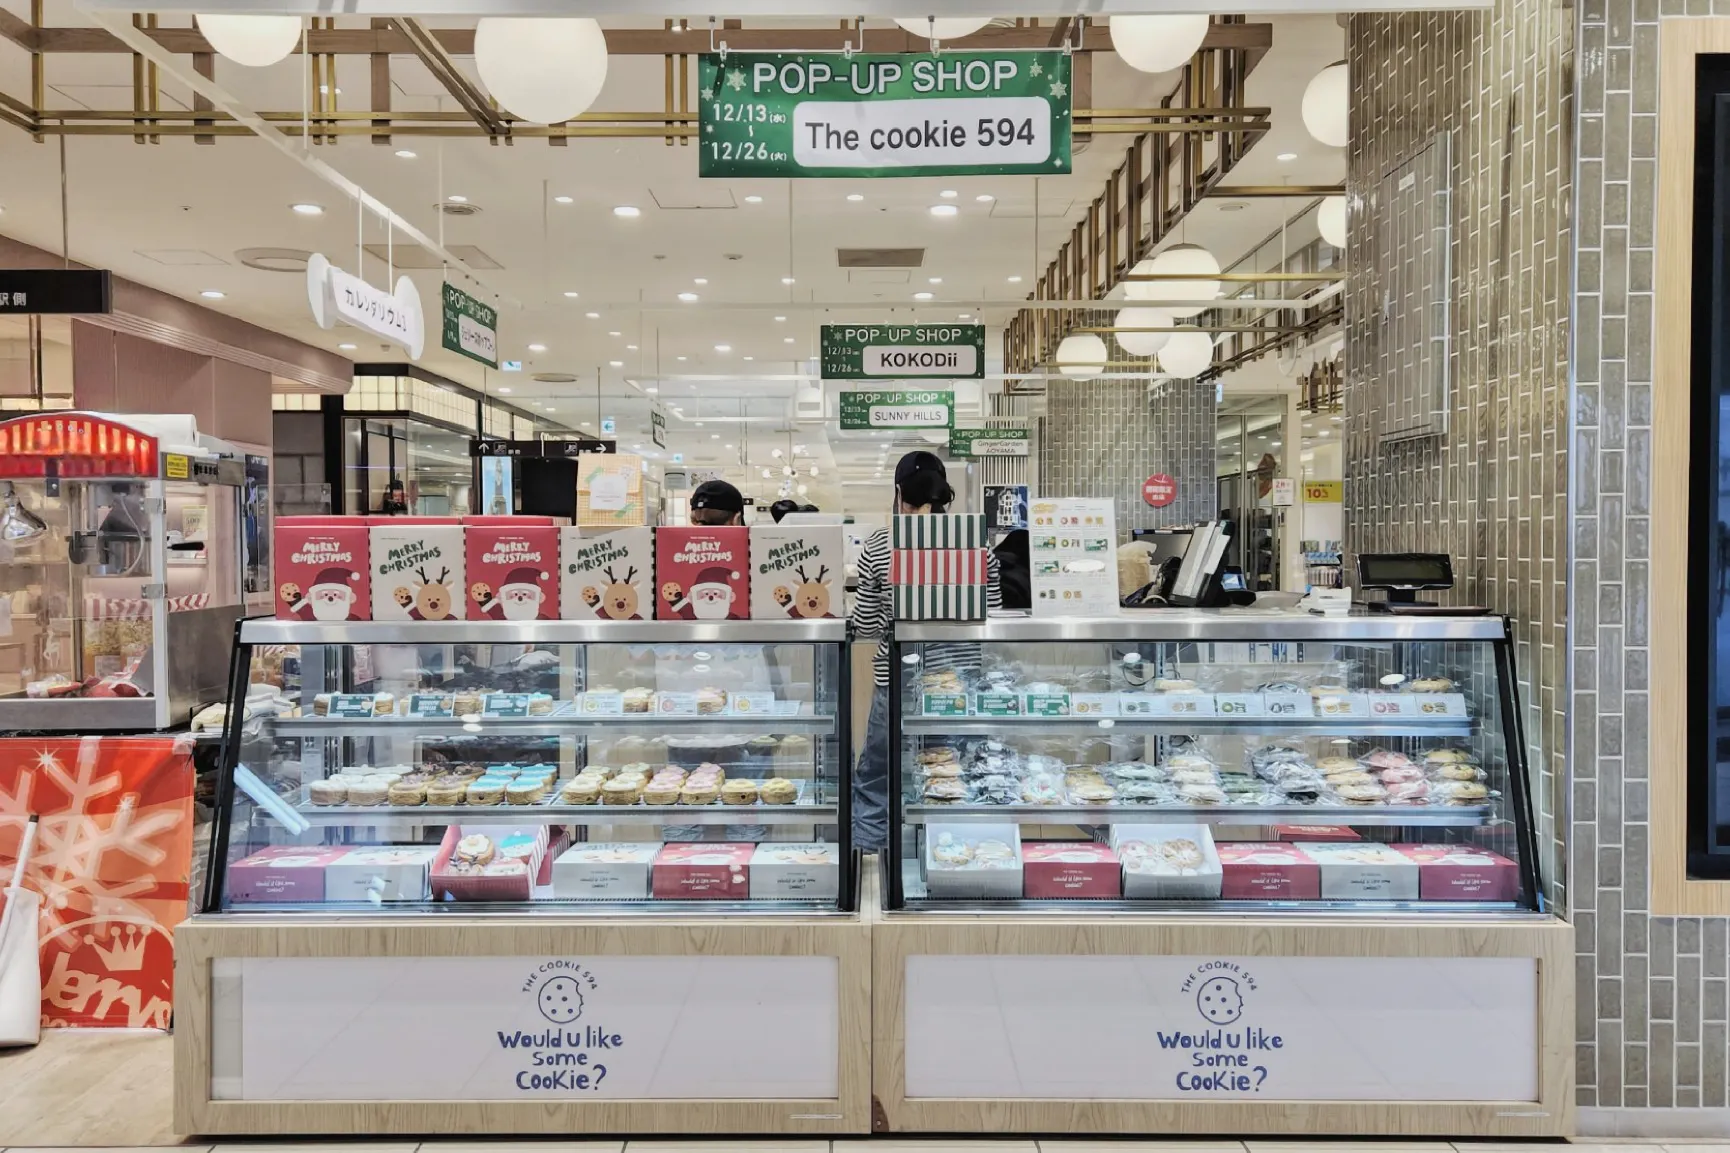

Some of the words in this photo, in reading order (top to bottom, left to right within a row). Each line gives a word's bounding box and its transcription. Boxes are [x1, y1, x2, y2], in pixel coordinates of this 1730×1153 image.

[752, 62, 902, 95] POP-UP
[911, 59, 1019, 93] SHOP
[805, 122, 860, 151] The
[870, 118, 967, 149] cookie
[976, 117, 1036, 147] 594
[844, 328, 911, 343] POP-UP
[915, 328, 962, 342] SHOP
[905, 392, 938, 403] SHOP
[874, 411, 910, 421] SUNNY
[913, 410, 942, 421] HILLS
[302, 541, 341, 553] MERRY
[388, 540, 425, 560] MERRY
[493, 541, 530, 553] MERRY
[577, 540, 614, 560] MERRY
[684, 541, 722, 553] MERRY
[768, 539, 804, 560] MERRY
[522, 972, 539, 993] THE
[539, 959, 581, 974] COOKIE
[582, 970, 599, 991] 594
[1181, 973, 1197, 994] THE
[1197, 960, 1241, 974] COOKIE
[1241, 972, 1258, 992] 594
[497, 1028, 563, 1049] Would
[586, 1025, 624, 1050] like
[1156, 1028, 1222, 1050] Would
[1246, 1026, 1284, 1051] like
